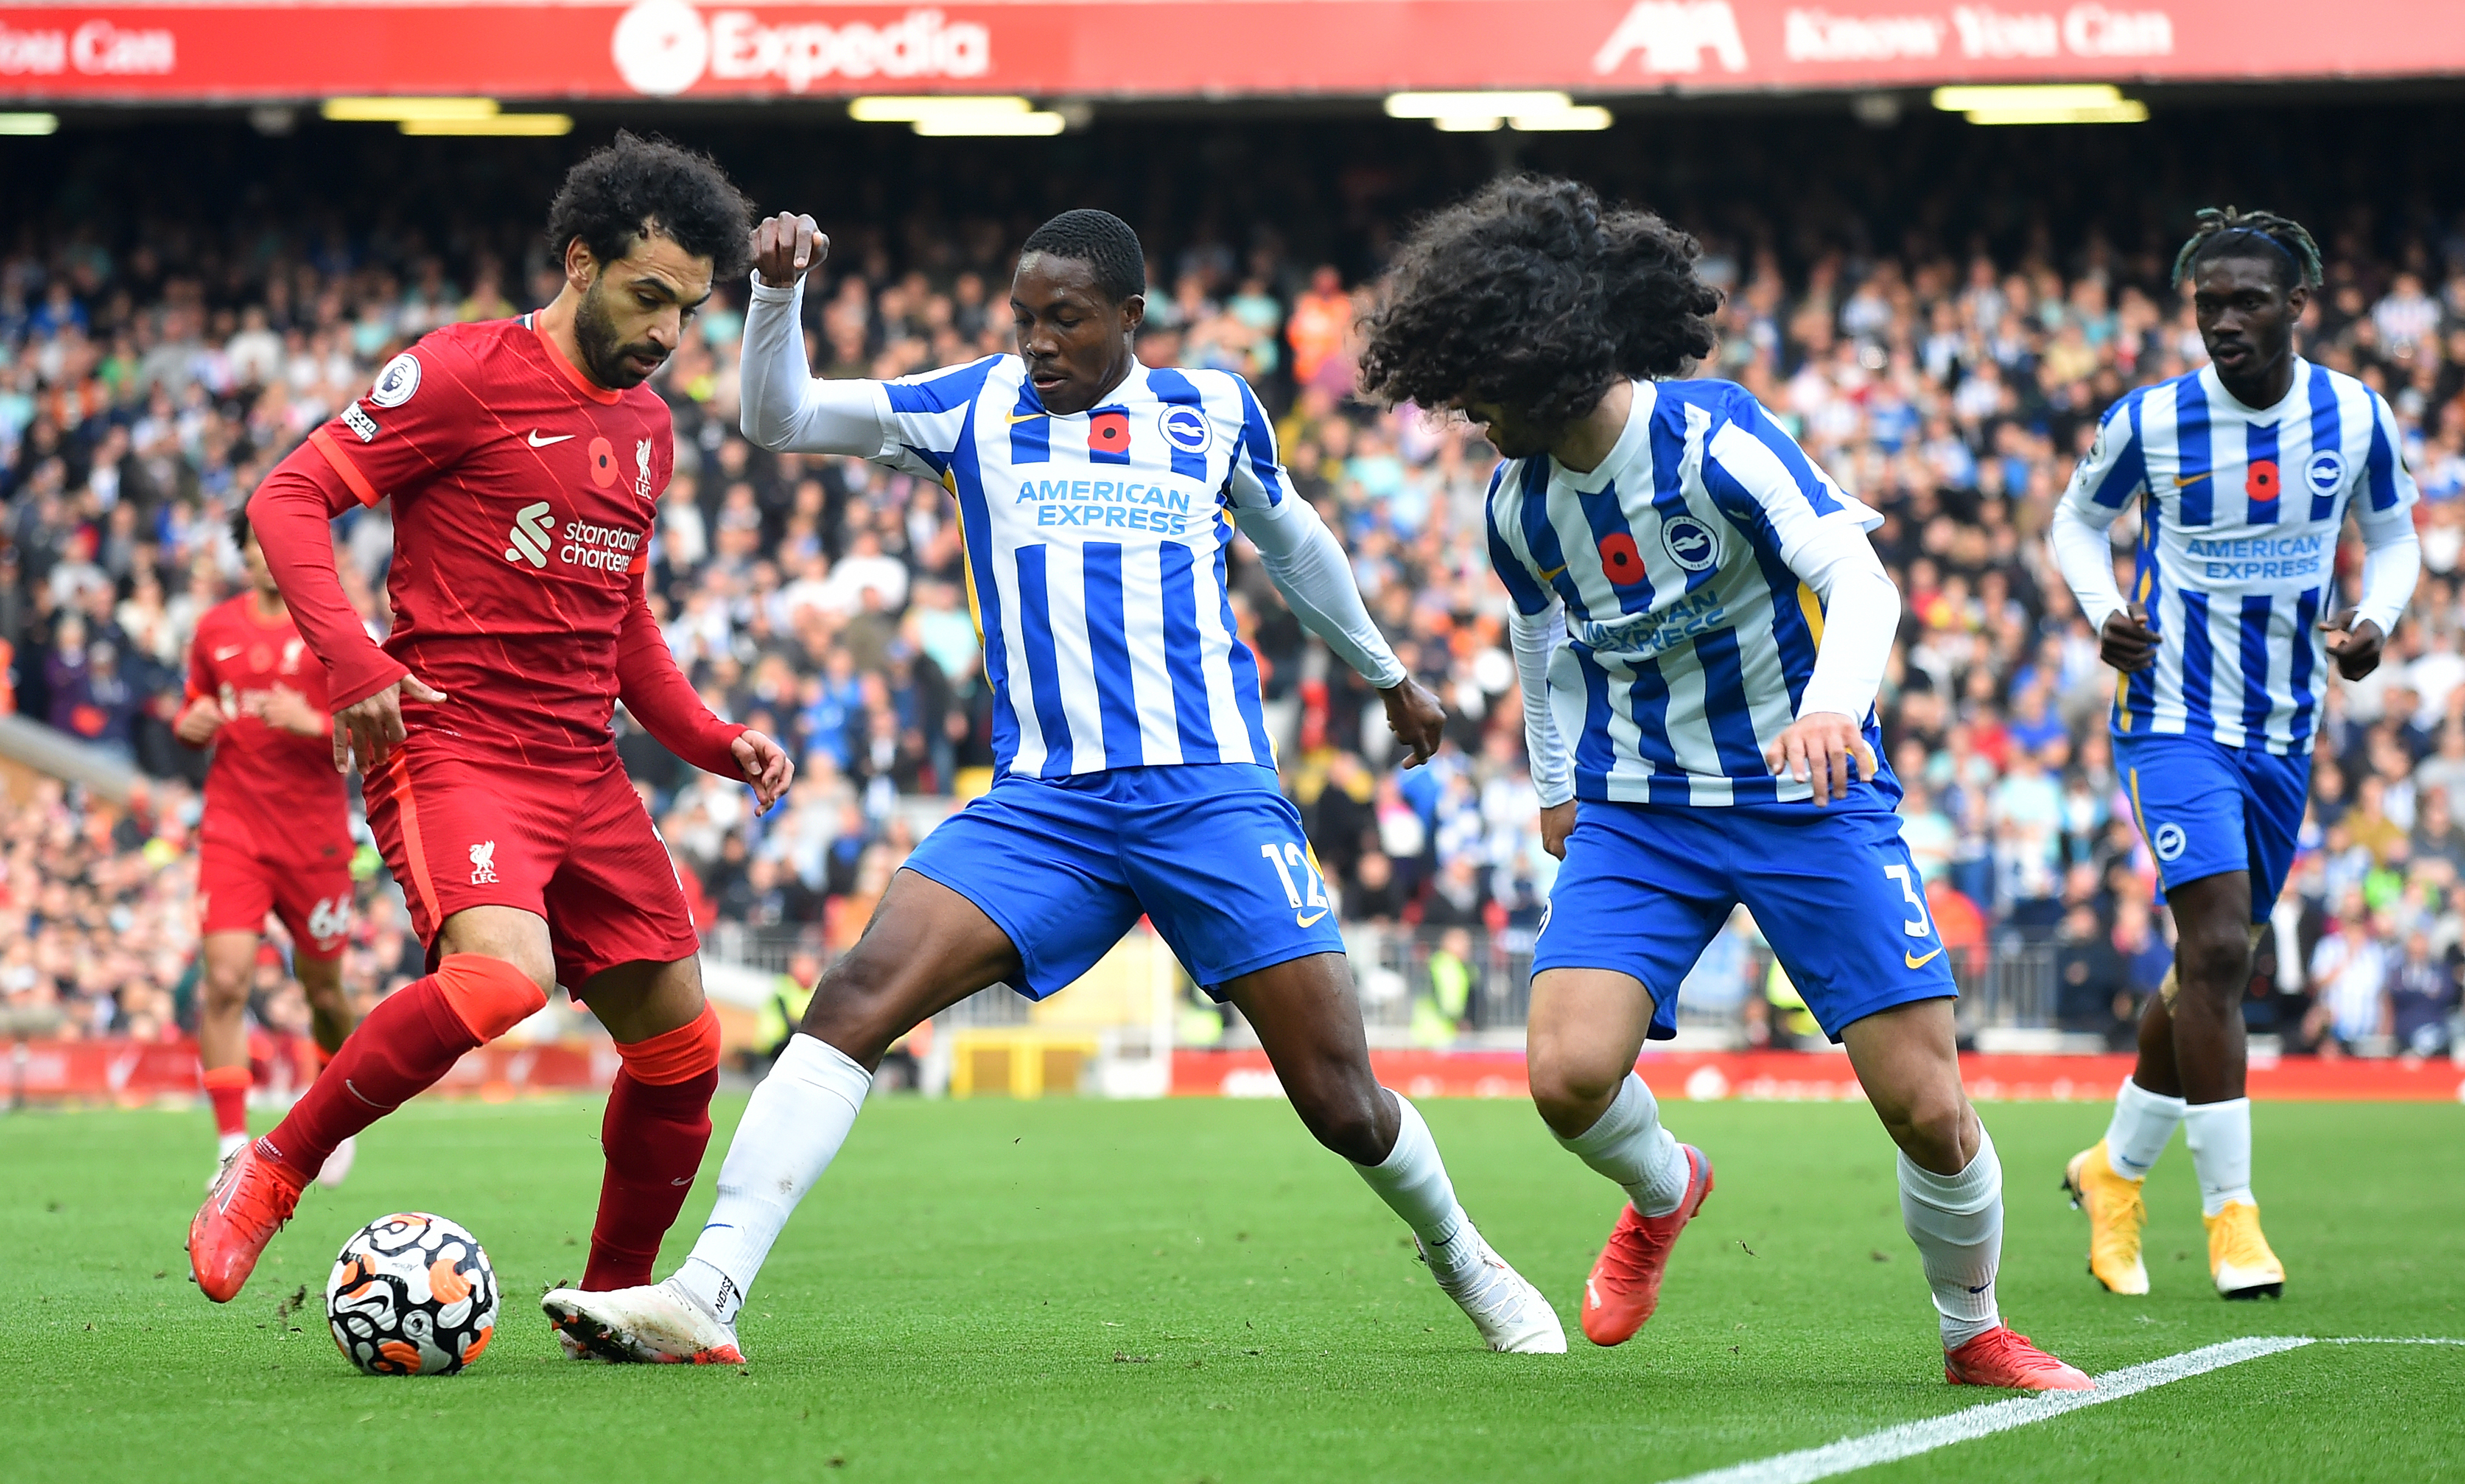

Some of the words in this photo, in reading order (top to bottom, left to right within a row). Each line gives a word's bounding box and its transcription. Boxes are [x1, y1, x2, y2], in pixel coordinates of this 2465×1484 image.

[0, 19, 65, 75] ou
[70, 18, 175, 75] Can
[1951, 4, 2059, 59] You
[2063, 3, 2173, 56] Can
[1016, 480, 1190, 515] AMERICAN
[1037, 505, 1188, 536] EXPRESS
[560, 542, 633, 573] chartere
[2186, 535, 2322, 558] AMERICAN
[2206, 555, 2320, 579] EXPRESS
[1261, 842, 1329, 909] 12
[1883, 864, 1930, 937] 3
